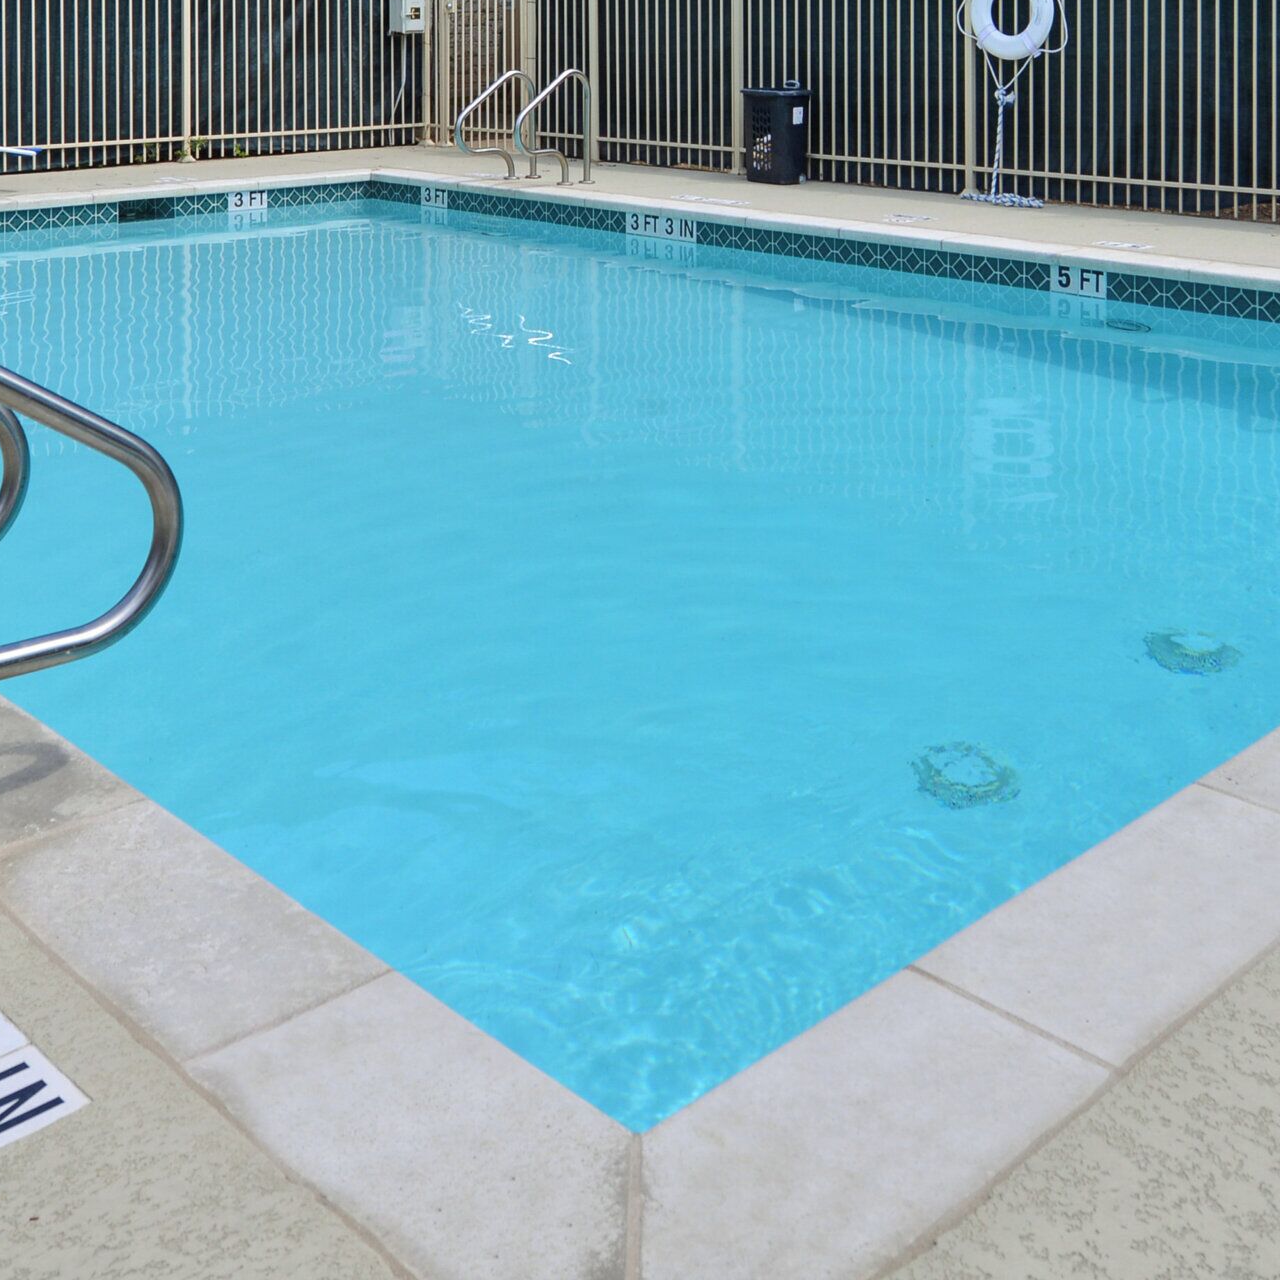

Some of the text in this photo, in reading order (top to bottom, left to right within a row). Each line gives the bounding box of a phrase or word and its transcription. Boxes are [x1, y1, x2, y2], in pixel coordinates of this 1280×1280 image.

[234, 190, 266, 207] 3 FT
[424, 187, 446, 205] 3 FT
[630, 213, 694, 238] 3 FT 3 IN
[1058, 265, 1104, 293] 5 FT
